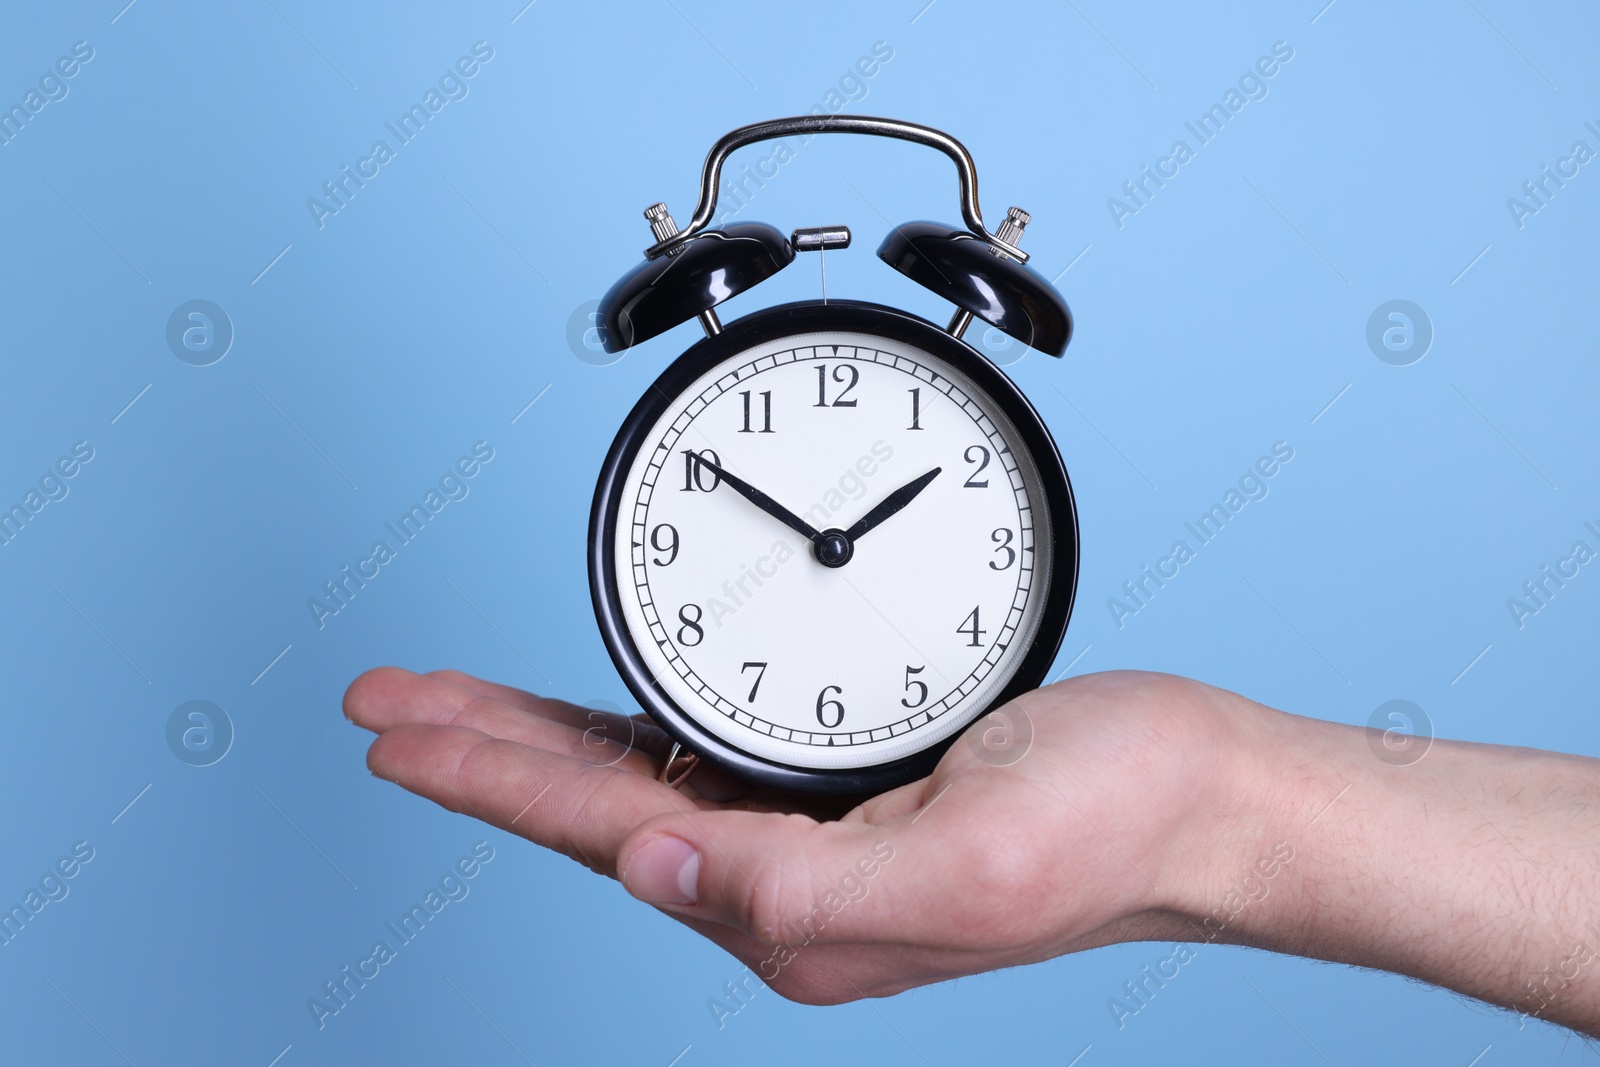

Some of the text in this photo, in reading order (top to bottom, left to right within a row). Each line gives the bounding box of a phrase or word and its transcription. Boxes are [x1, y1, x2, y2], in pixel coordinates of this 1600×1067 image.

[813, 364, 859, 408] 12
[738, 391, 775, 433] 11
[907, 388, 923, 431] 1
[680, 449, 721, 492] 10
[964, 446, 990, 488] 2
[651, 524, 679, 566] 9
[989, 528, 1015, 570] 3
[677, 604, 703, 646] 8
[957, 606, 986, 647] 4
[741, 662, 767, 703] 7
[902, 666, 927, 708] 5
[816, 686, 844, 728] 6
